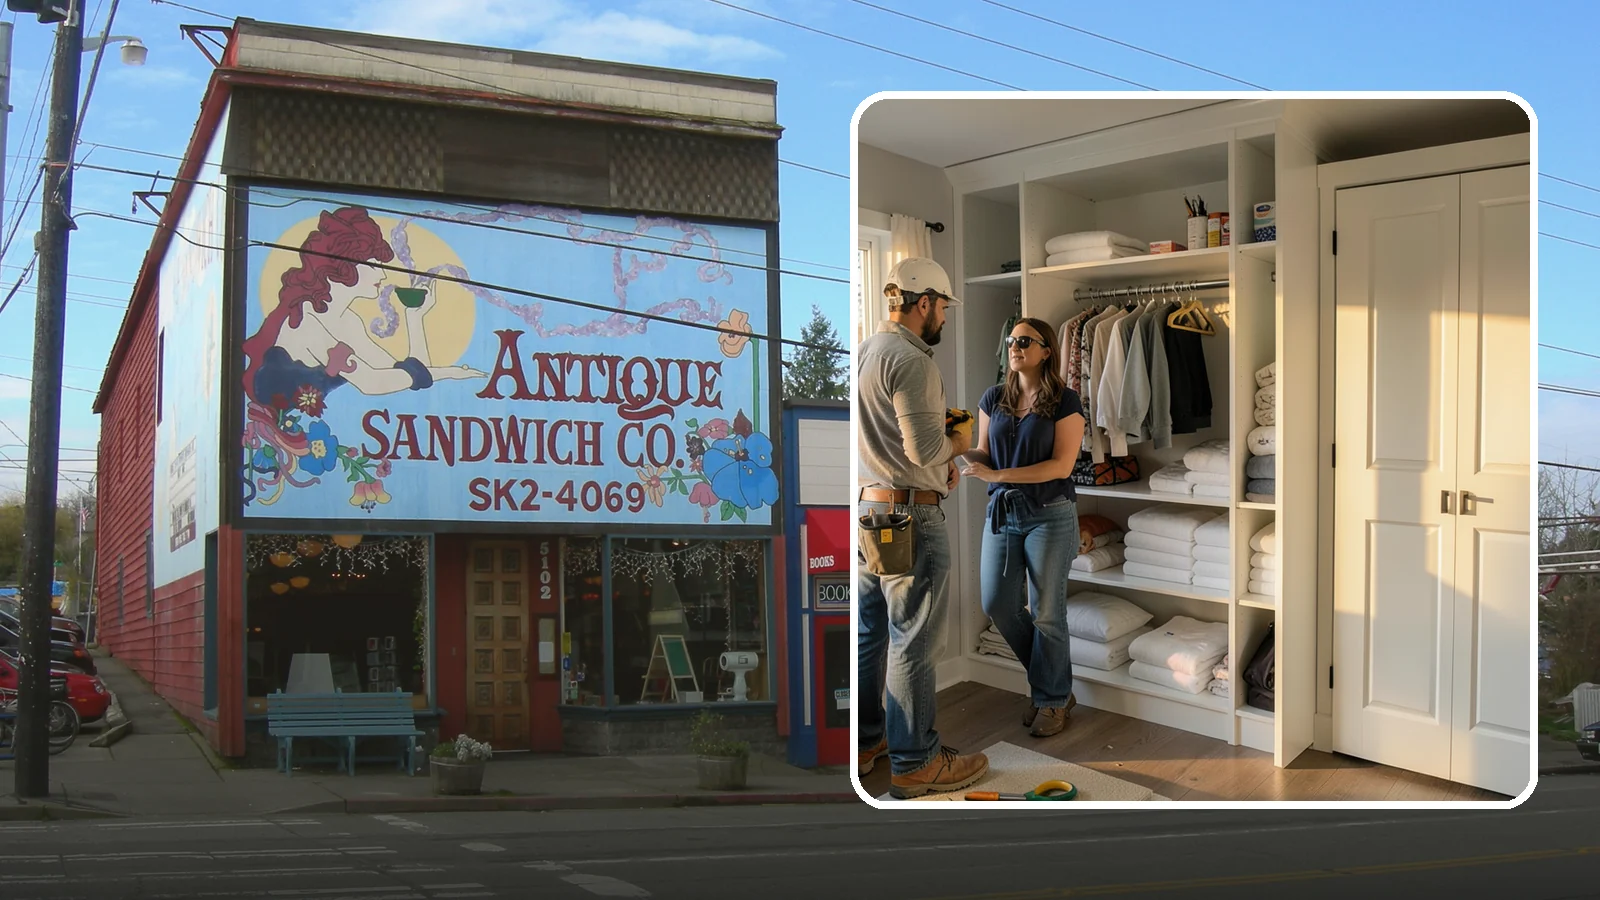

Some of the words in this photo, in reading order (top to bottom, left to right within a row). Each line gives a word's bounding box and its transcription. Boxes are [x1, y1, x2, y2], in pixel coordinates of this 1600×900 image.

[476, 329, 723, 420] ANTIQUE
[361, 409, 604, 467] SANDWICH
[617, 422, 684, 468] CO.
[468, 477, 645, 512] SK2-4069
[540, 541, 551, 600] 5102
[809, 555, 835, 569] BOOKS
